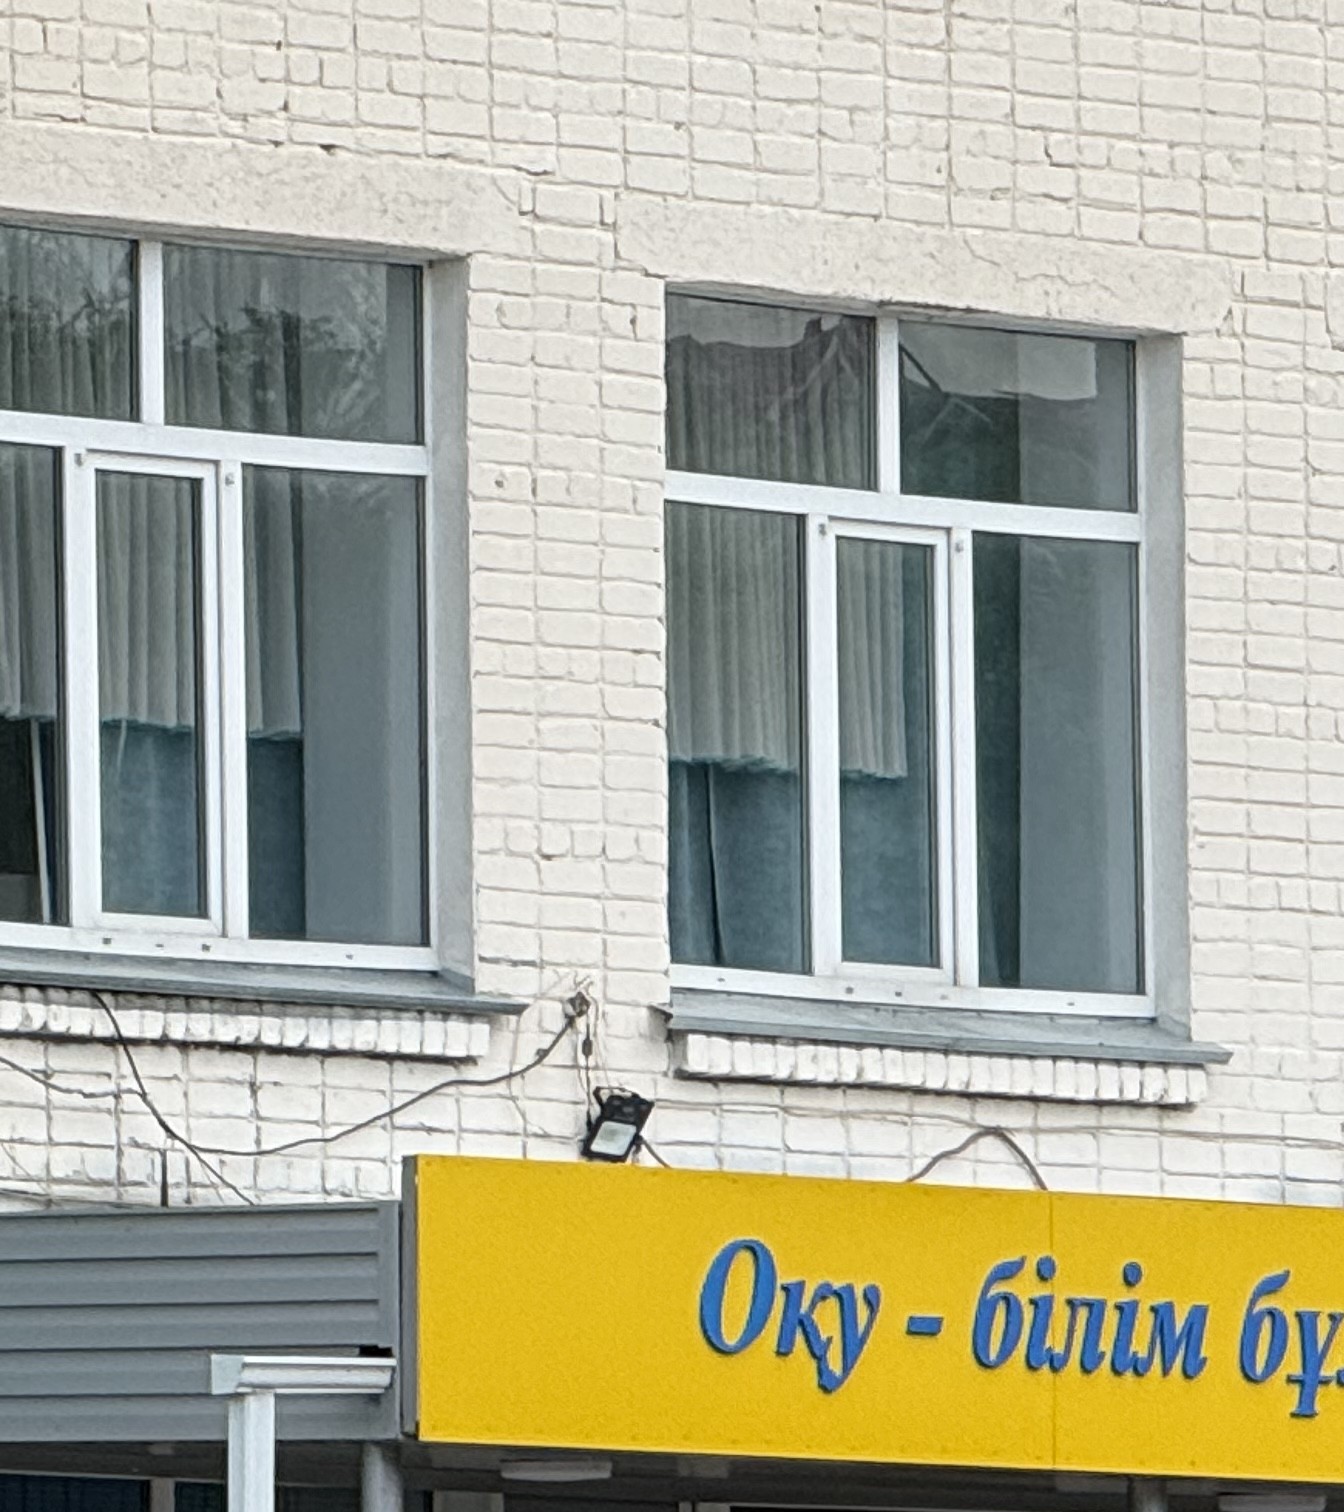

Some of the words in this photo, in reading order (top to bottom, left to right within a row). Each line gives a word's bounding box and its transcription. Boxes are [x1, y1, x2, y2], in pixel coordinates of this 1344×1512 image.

[699, 1239, 881, 1392] Оқу
[907, 1315, 943, 1335] -
[972, 1255, 1208, 1378] білім
